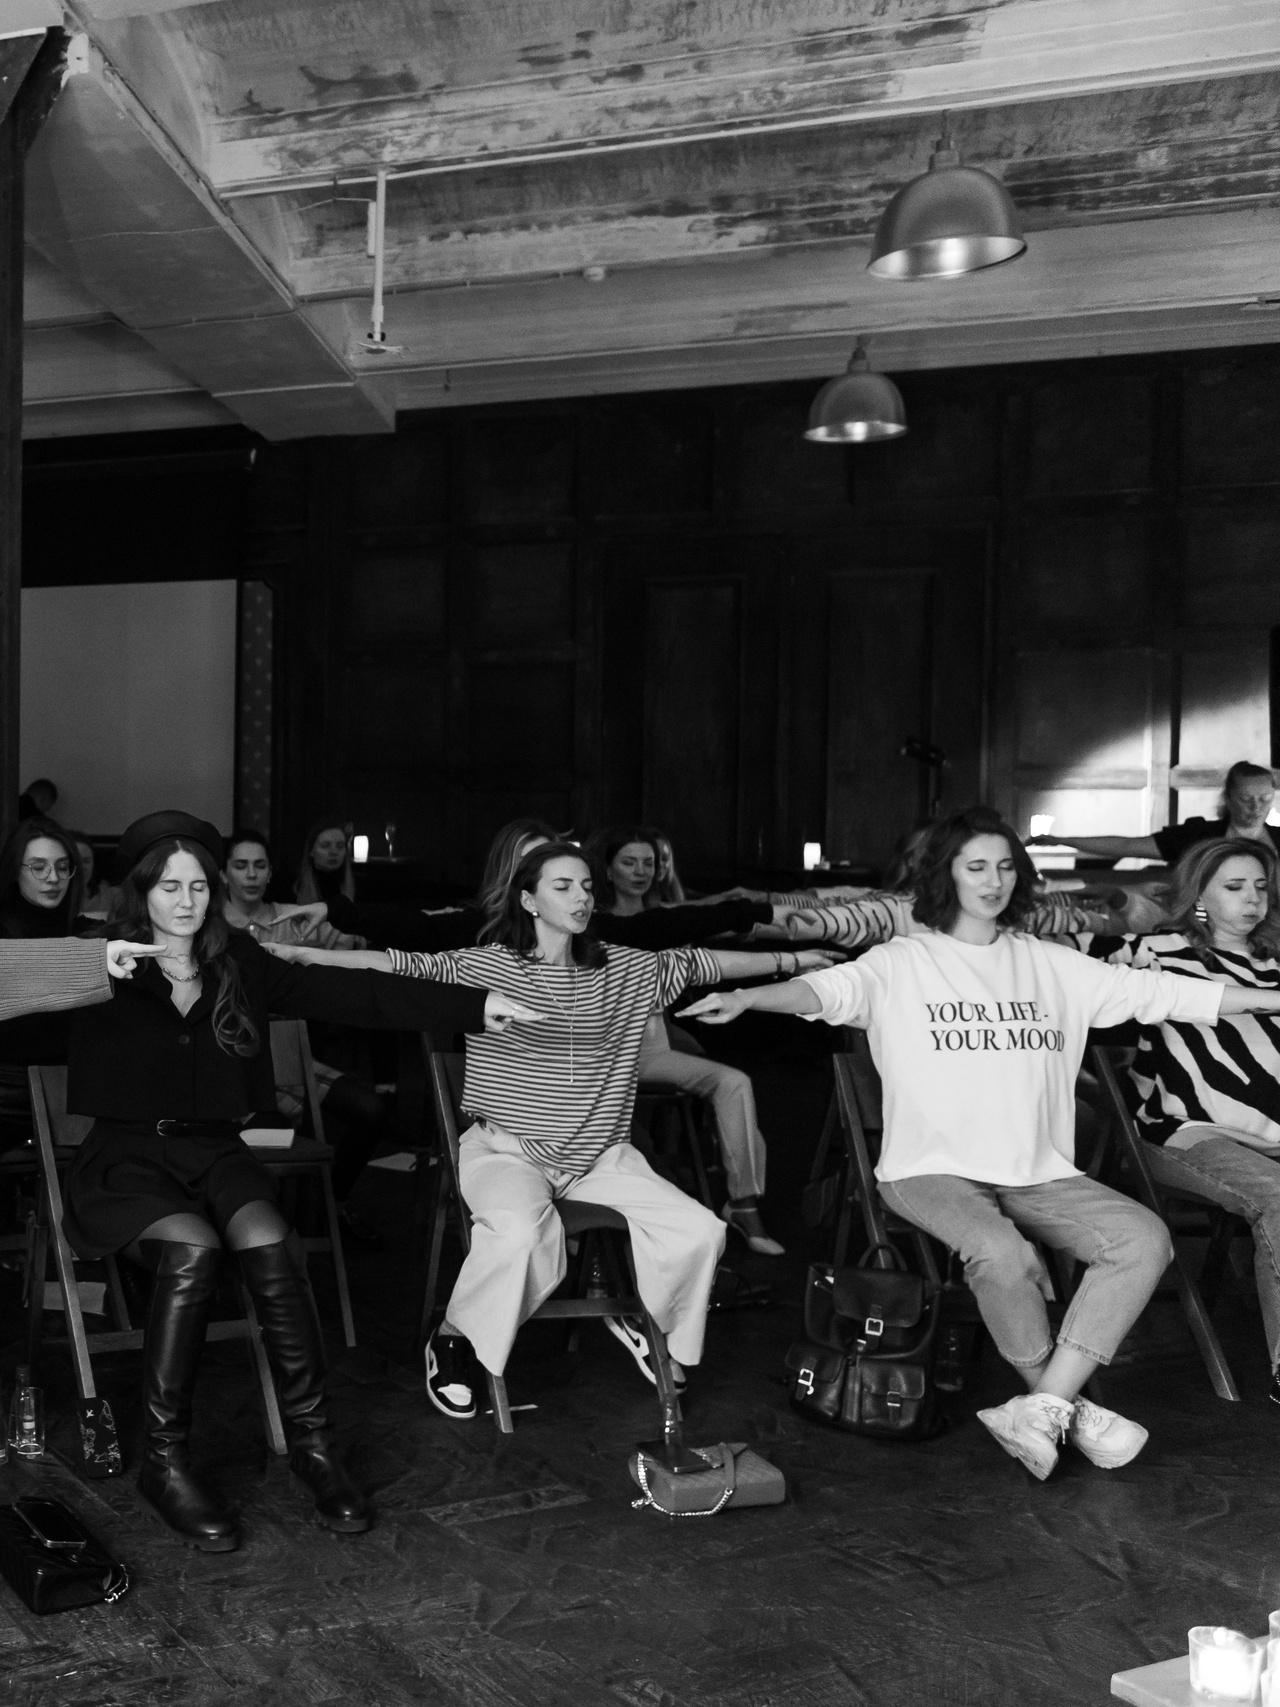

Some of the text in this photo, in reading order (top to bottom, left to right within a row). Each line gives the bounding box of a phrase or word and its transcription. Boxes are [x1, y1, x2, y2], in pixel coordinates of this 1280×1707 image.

[925, 1001, 994, 1023] YOUR
[995, 1001, 1042, 1022] LIFE
[930, 1028, 1065, 1052] YOUR MOOD
